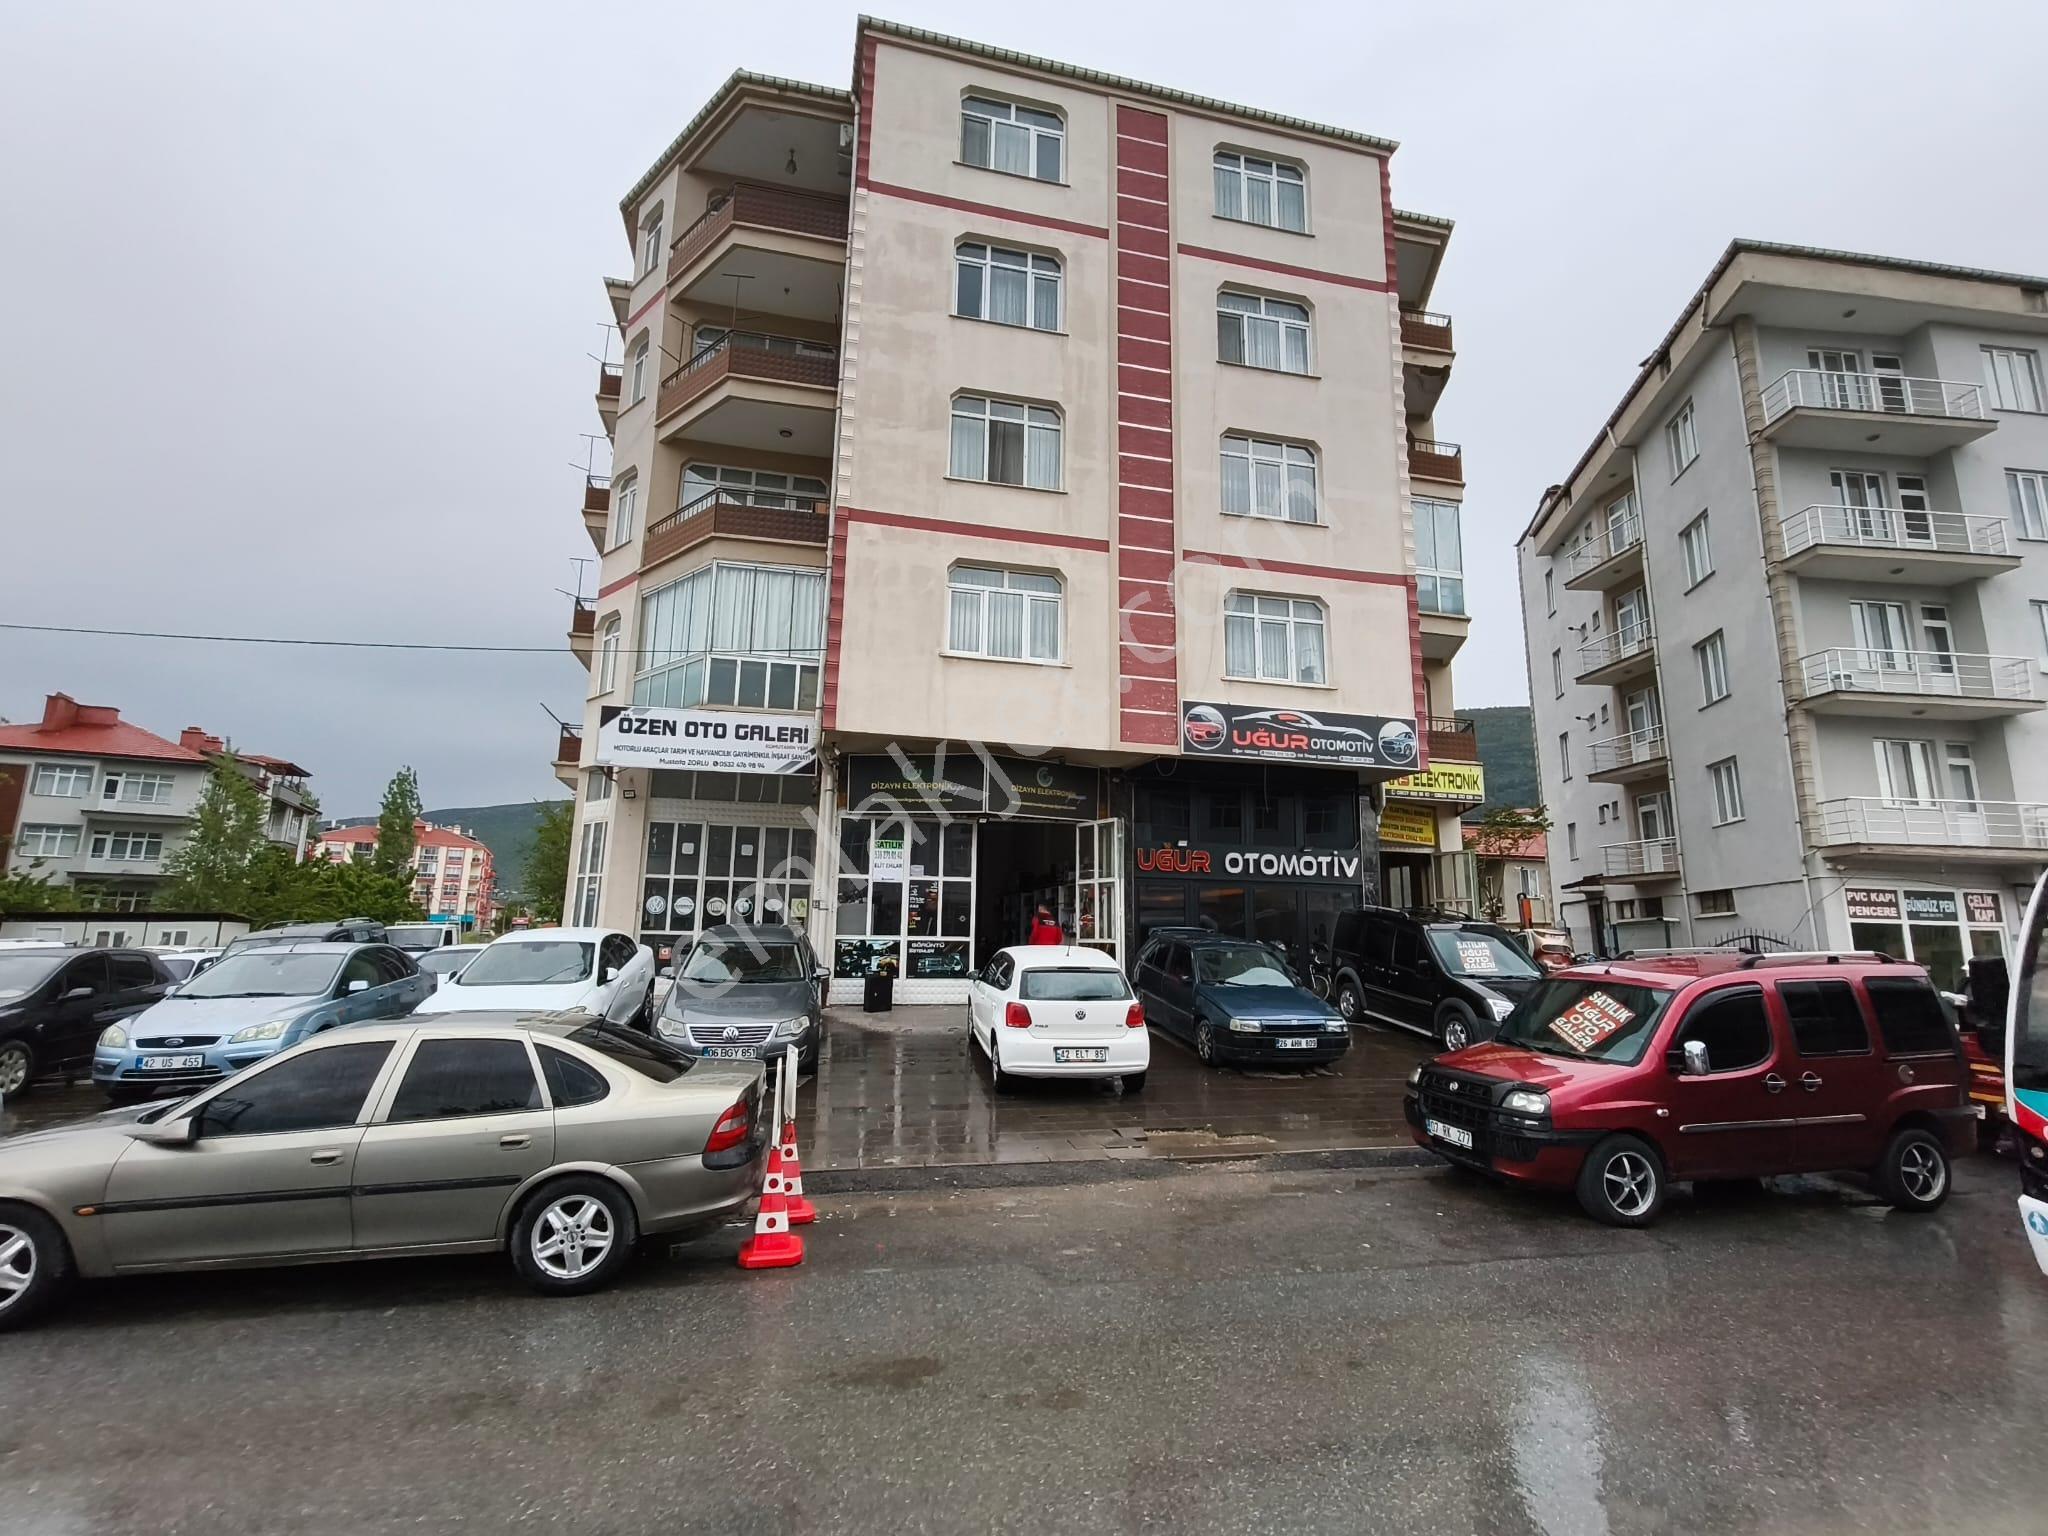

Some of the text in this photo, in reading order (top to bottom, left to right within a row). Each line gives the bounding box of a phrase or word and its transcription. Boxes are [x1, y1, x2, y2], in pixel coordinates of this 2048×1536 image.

[618, 713, 809, 744] ÖZEN OTO GALERİ
[1232, 728, 1374, 753] UĞUR OTOMOTİV
[613, 744, 642, 752] MOTORLU
[642, 746, 669, 754] ARAÇLAR
[696, 748, 731, 757] HAYVANCILIK
[732, 750, 770, 758] GAYRİMENKUL
[771, 752, 790, 761] İNŞAAT
[659, 758, 686, 766] Mustafa
[871, 781, 900, 790] DİZAYN
[902, 781, 952, 790] ELEKTRONİK
[1413, 769, 1480, 791] ELEKTRONİK
[1011, 784, 1036, 794] DİZAYN
[874, 841, 904, 849] SATILIK
[1137, 843, 1359, 878] UĞUR OTOMOTİV
[1846, 891, 1896, 903] PVC KAPI
[1967, 894, 1995, 910] ÇELİK
[1848, 905, 1898, 917] PENCERE
[1904, 897, 1955, 913] GÜNDÜZ PEN
[1974, 908, 1997, 922] KAPI
[1456, 941, 1488, 949] SATILIK
[1460, 948, 1490, 957] UĞUR
[1588, 991, 1633, 1023] SATILIK
[1575, 1001, 1616, 1032] UĞUR
[1554, 1016, 1598, 1047] GALERİ
[1569, 1013, 1600, 1036] OTO
[709, 1048, 756, 1057] 06 BGY 851
[1060, 1050, 1070, 1059] 42
[1075, 1050, 1089, 1059] ELT
[143, 1057, 200, 1068] 42 US 455
[1430, 1120, 1439, 1133] 07
[1457, 1130, 1470, 1145] 277
